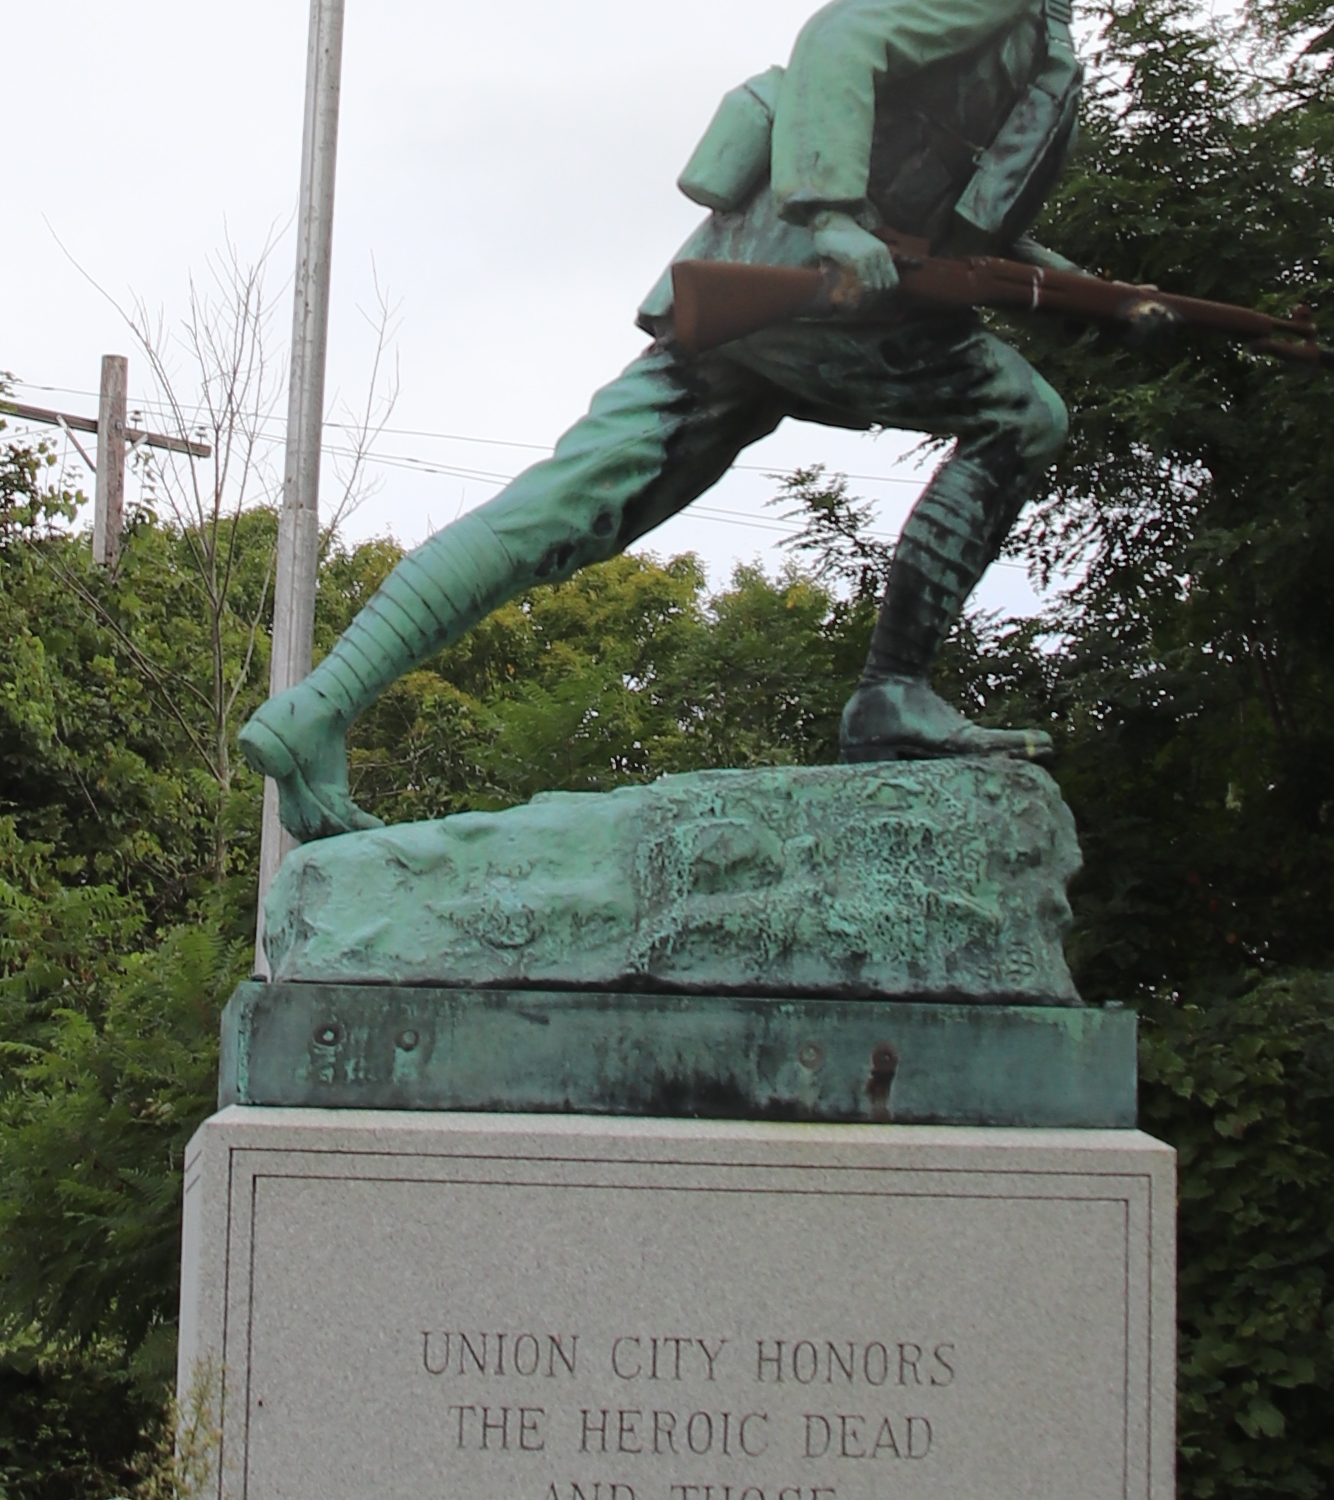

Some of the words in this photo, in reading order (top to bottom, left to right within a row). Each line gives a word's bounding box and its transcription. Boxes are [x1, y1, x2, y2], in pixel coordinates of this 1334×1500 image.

[421, 1331, 580, 1378] UNION
[611, 1335, 729, 1382] CITY
[756, 1339, 957, 1387] HONORS
[449, 1404, 546, 1450] THE
[579, 1408, 769, 1457] HEROIC
[802, 1413, 934, 1460] DEAD
